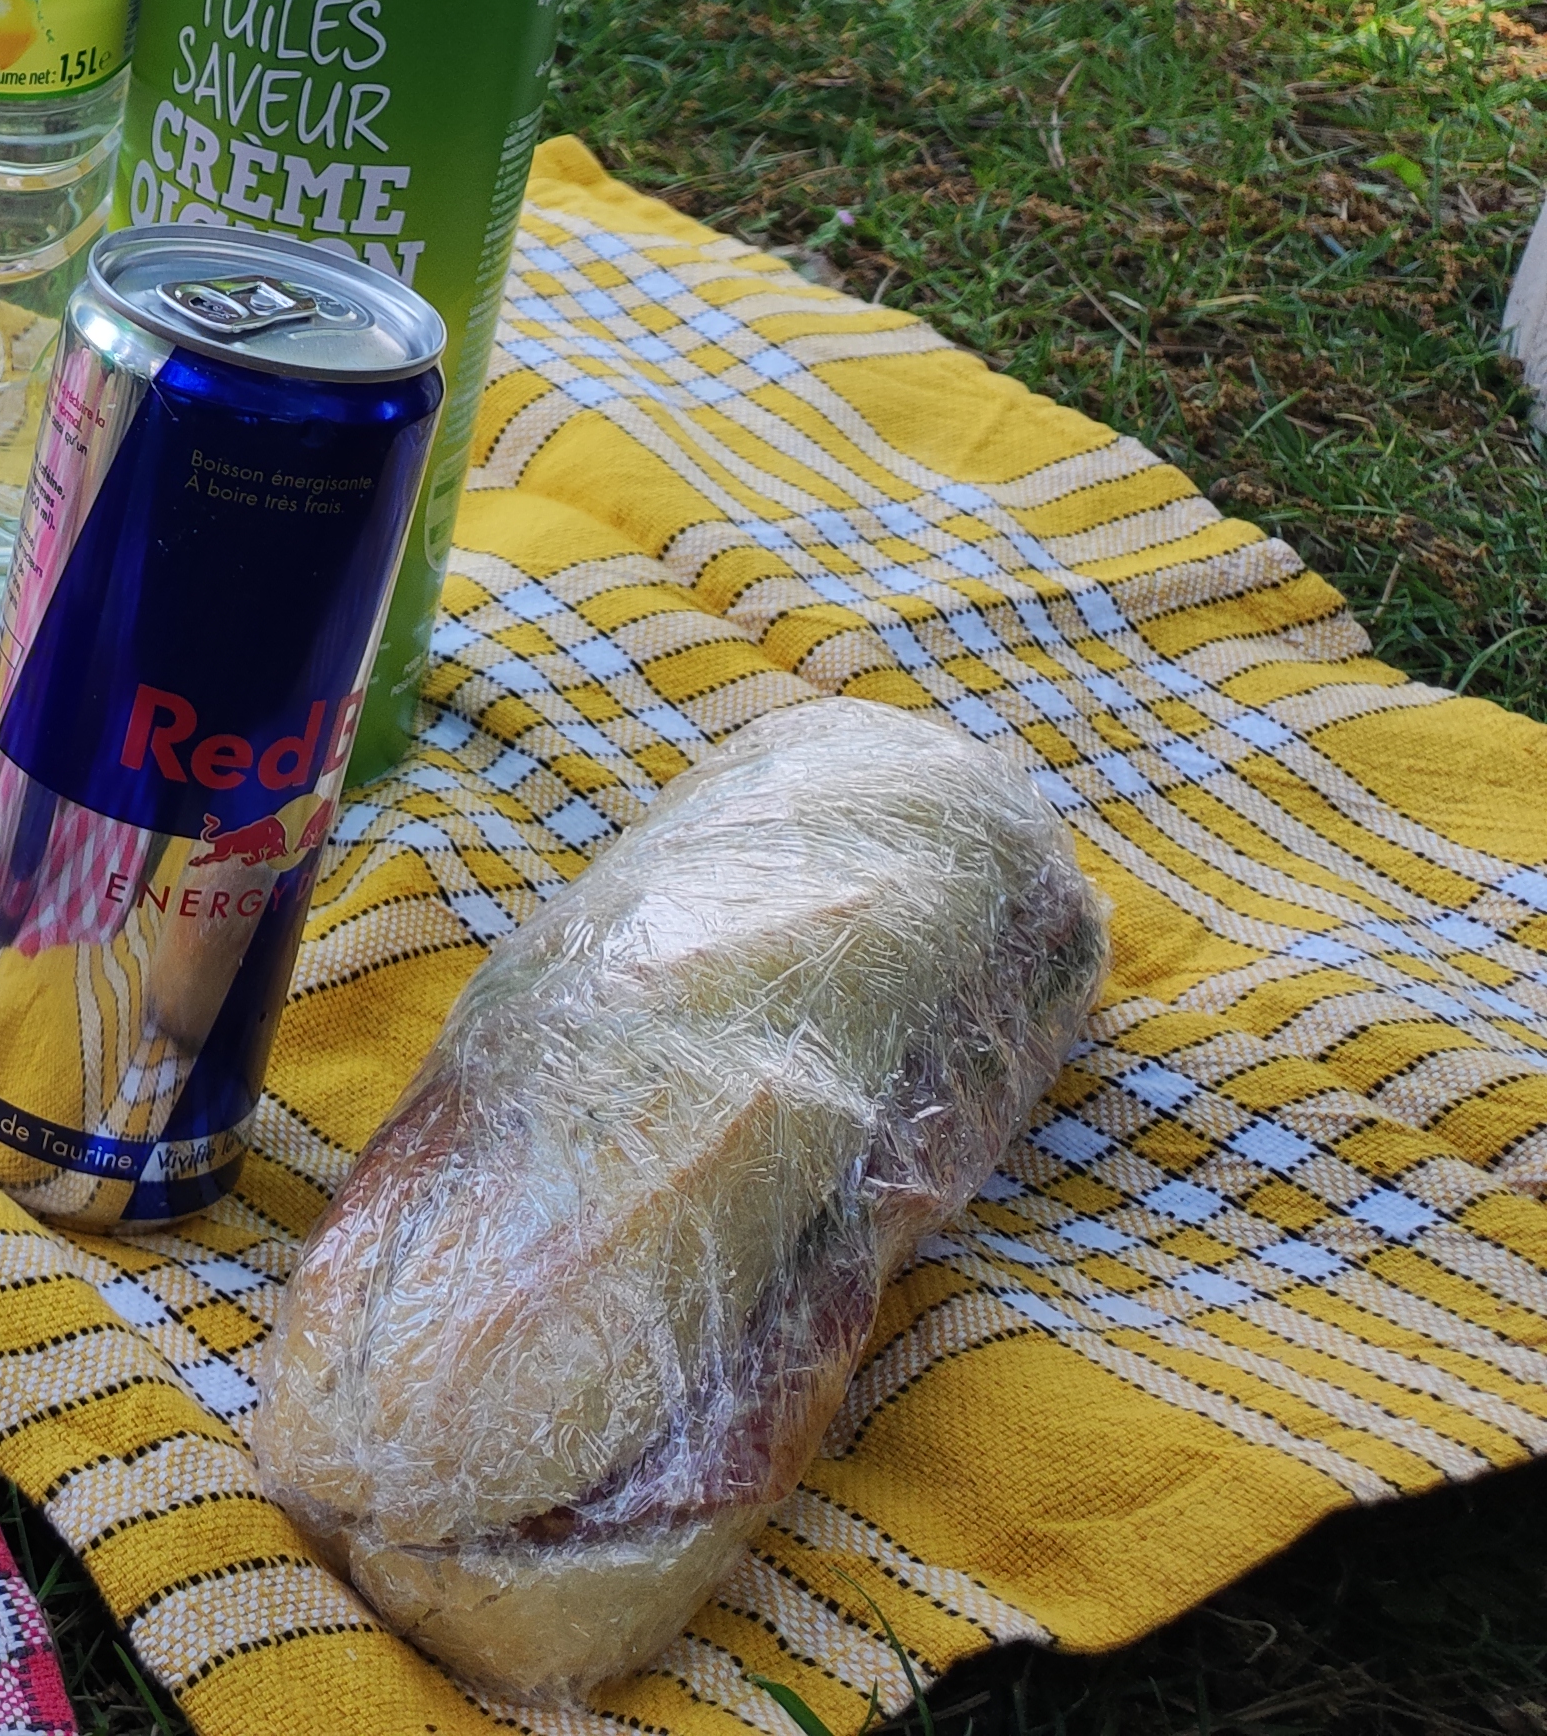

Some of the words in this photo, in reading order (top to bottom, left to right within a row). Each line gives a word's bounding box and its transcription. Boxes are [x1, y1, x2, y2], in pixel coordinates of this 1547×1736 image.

[172, 26, 391, 153] SAVEUR
[151, 99, 411, 235] CRÈME
[95, 409, 105, 428] la
[191, 448, 265, 486] Boisson
[271, 468, 376, 497] énergisante.
[207, 480, 258, 507] boire
[264, 492, 299, 514] très
[303, 493, 345, 516] frais.
[120, 683, 327, 790] Red
[106, 870, 289, 919] ENERGY
[0, 1114, 31, 1142] de
[40, 1128, 139, 1171] Taurine.
